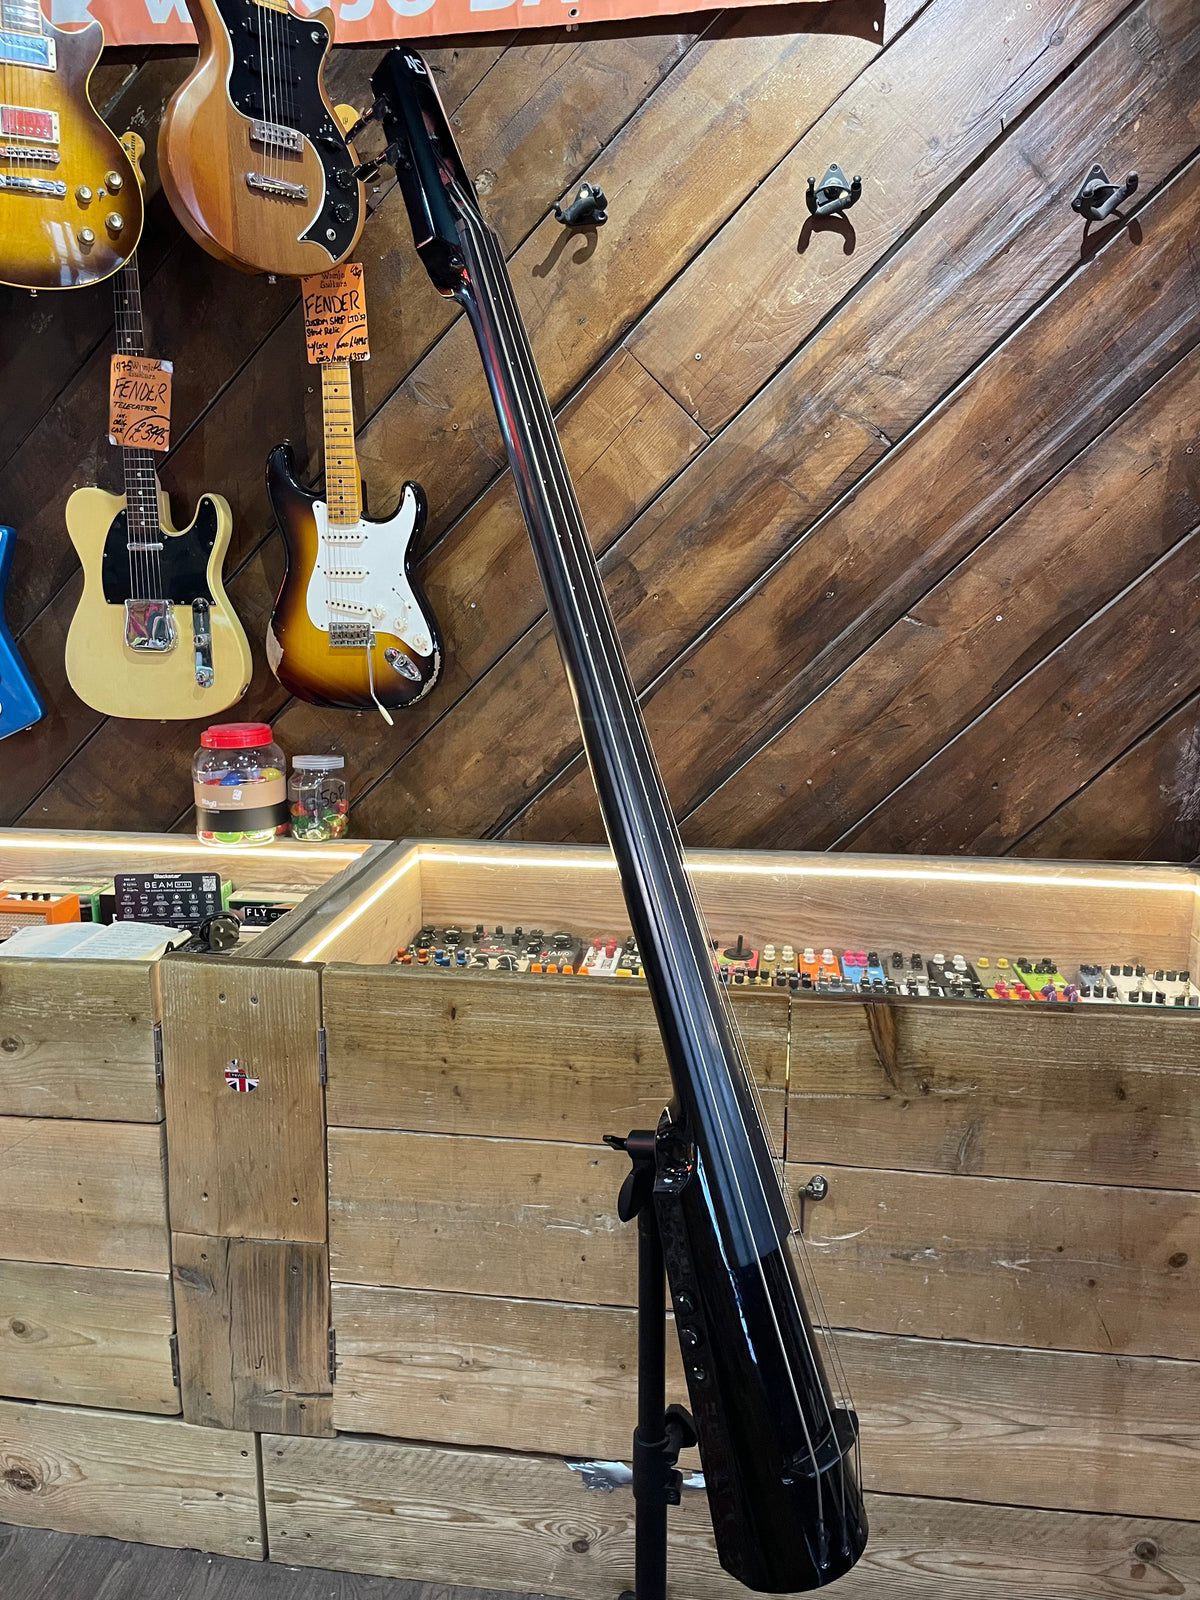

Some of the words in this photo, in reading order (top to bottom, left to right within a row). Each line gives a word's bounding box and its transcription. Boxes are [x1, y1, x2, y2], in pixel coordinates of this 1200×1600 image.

[304, 290, 360, 318] FENDER
[113, 378, 166, 404] FENDER
[113, 401, 158, 413] TELECASTER
[144, 881, 173, 889] BEAM
[246, 908, 267, 917] FLY
